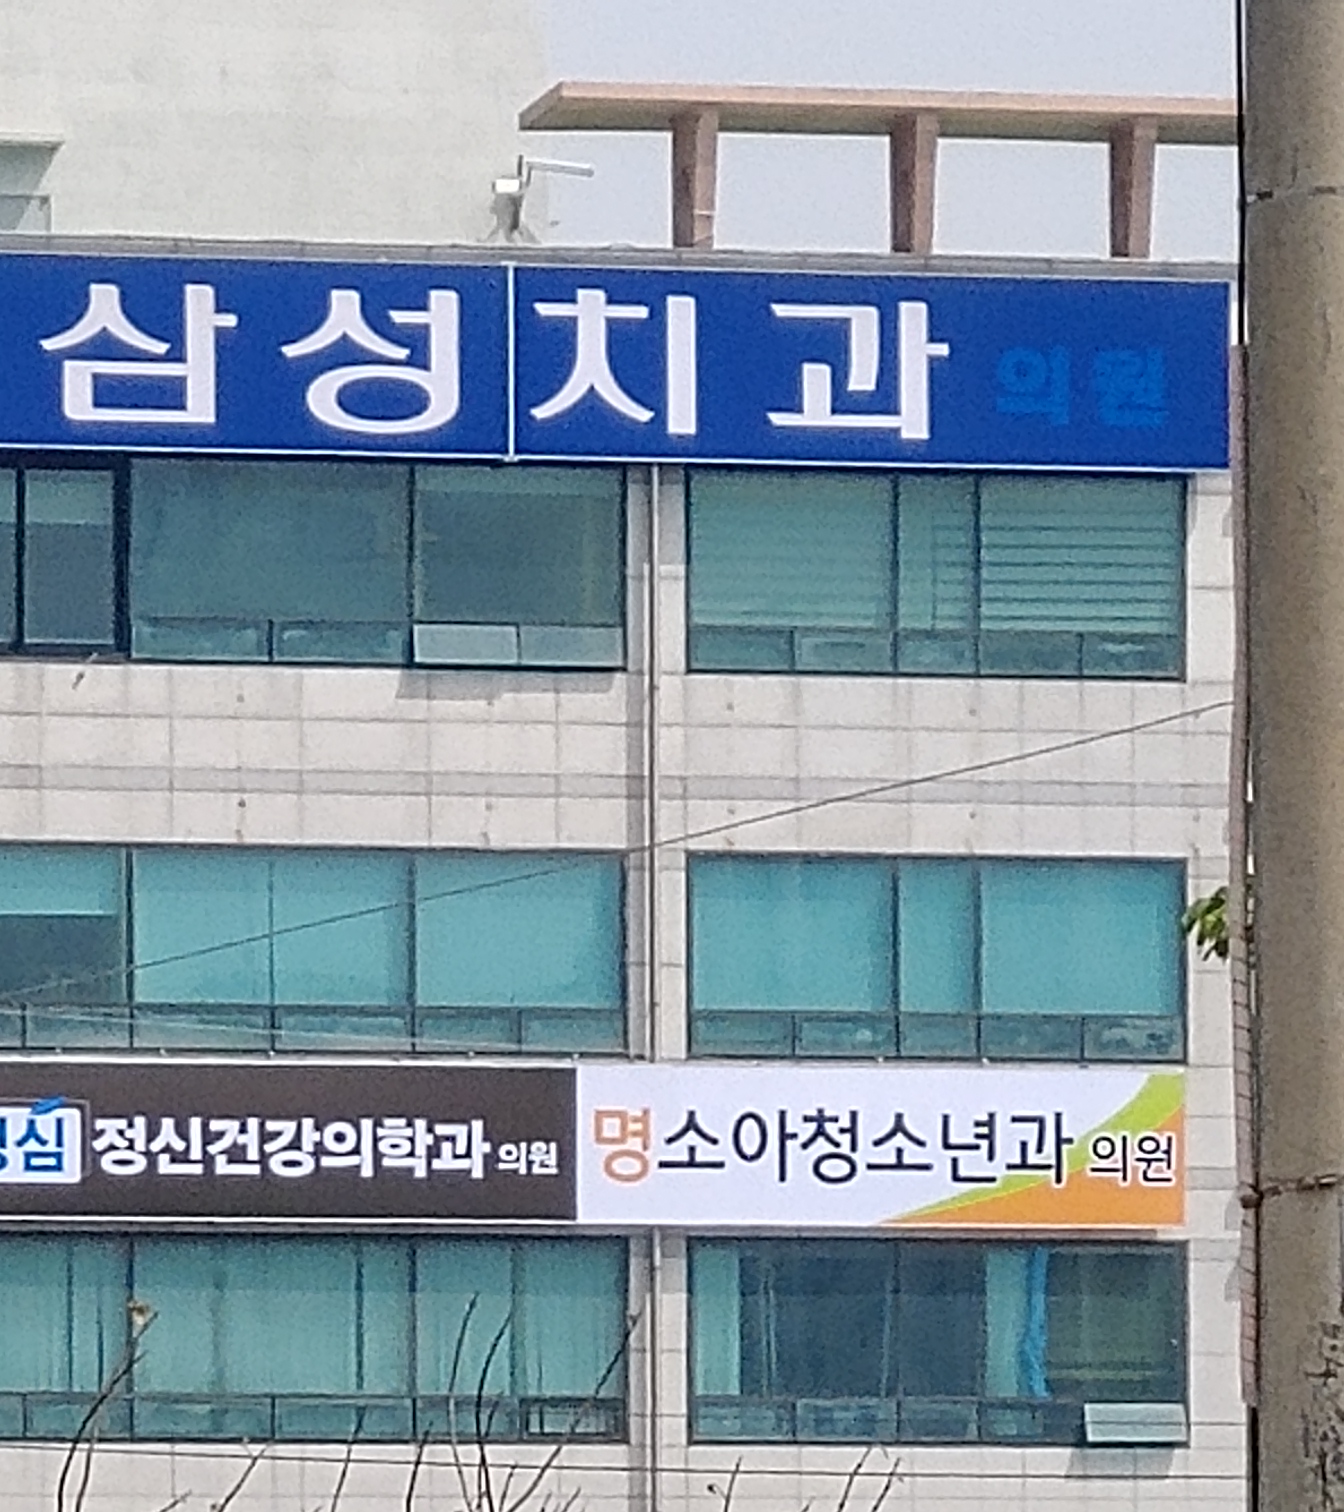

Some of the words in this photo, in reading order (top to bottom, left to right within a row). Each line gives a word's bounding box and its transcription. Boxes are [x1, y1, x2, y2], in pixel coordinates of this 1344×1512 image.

[996, 346, 1168, 426] 의원
[91, 1116, 491, 1179] 정신건강의학과
[496, 1141, 559, 1175] 의원
[1090, 1133, 1175, 1184] 의원
